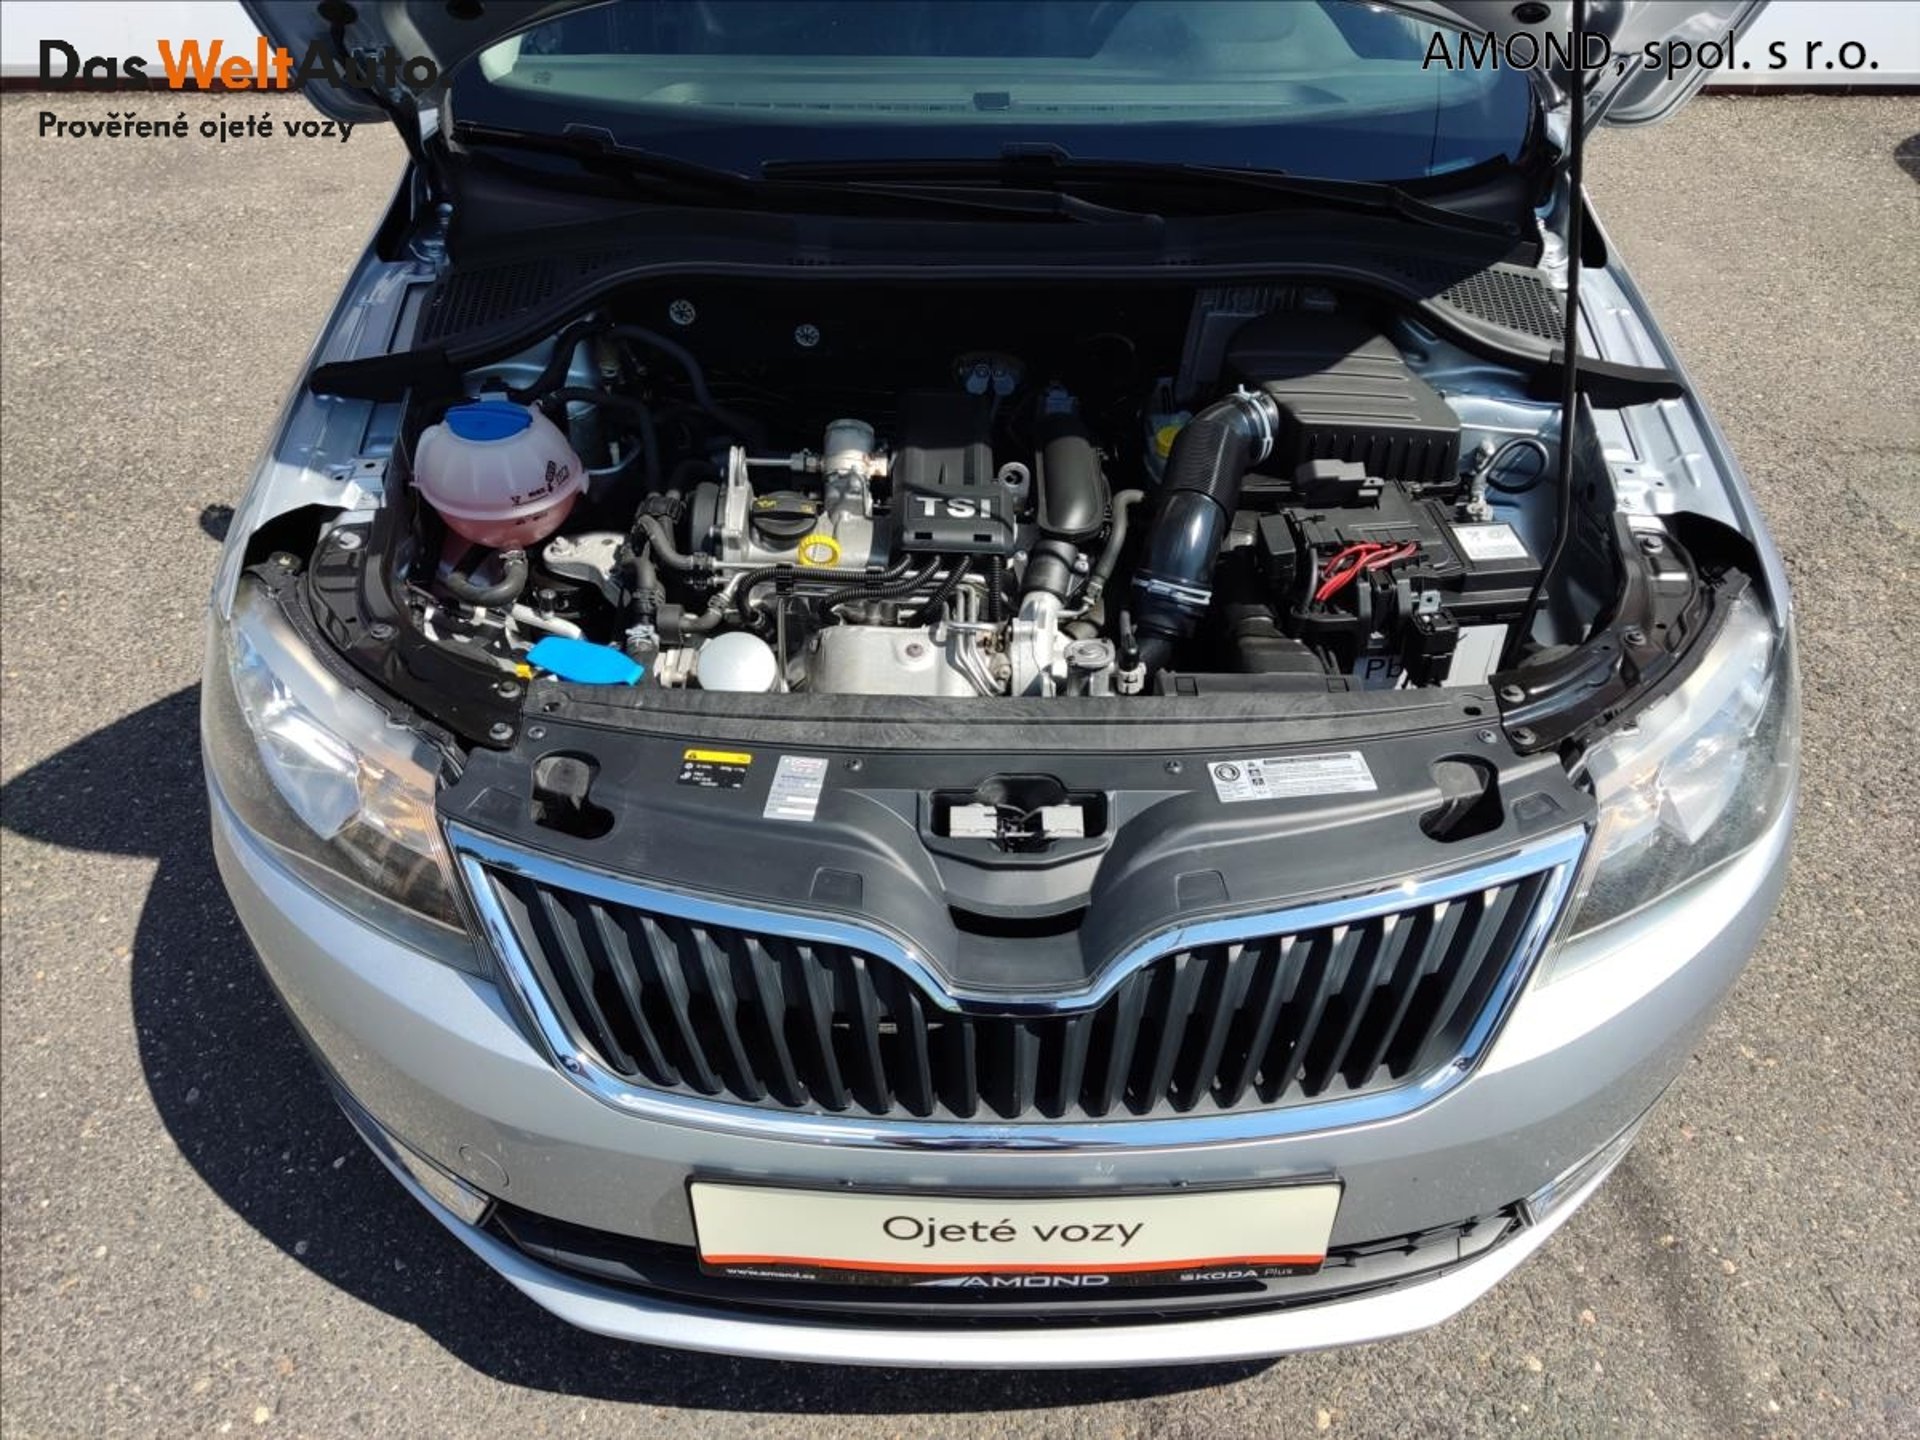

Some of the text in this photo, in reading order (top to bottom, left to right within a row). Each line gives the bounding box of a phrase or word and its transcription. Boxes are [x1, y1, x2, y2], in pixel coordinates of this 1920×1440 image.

[916, 497, 991, 518] TSI
[883, 1215, 1144, 1248] Ojeté vozy
[964, 1275, 1109, 1287] AMOND
